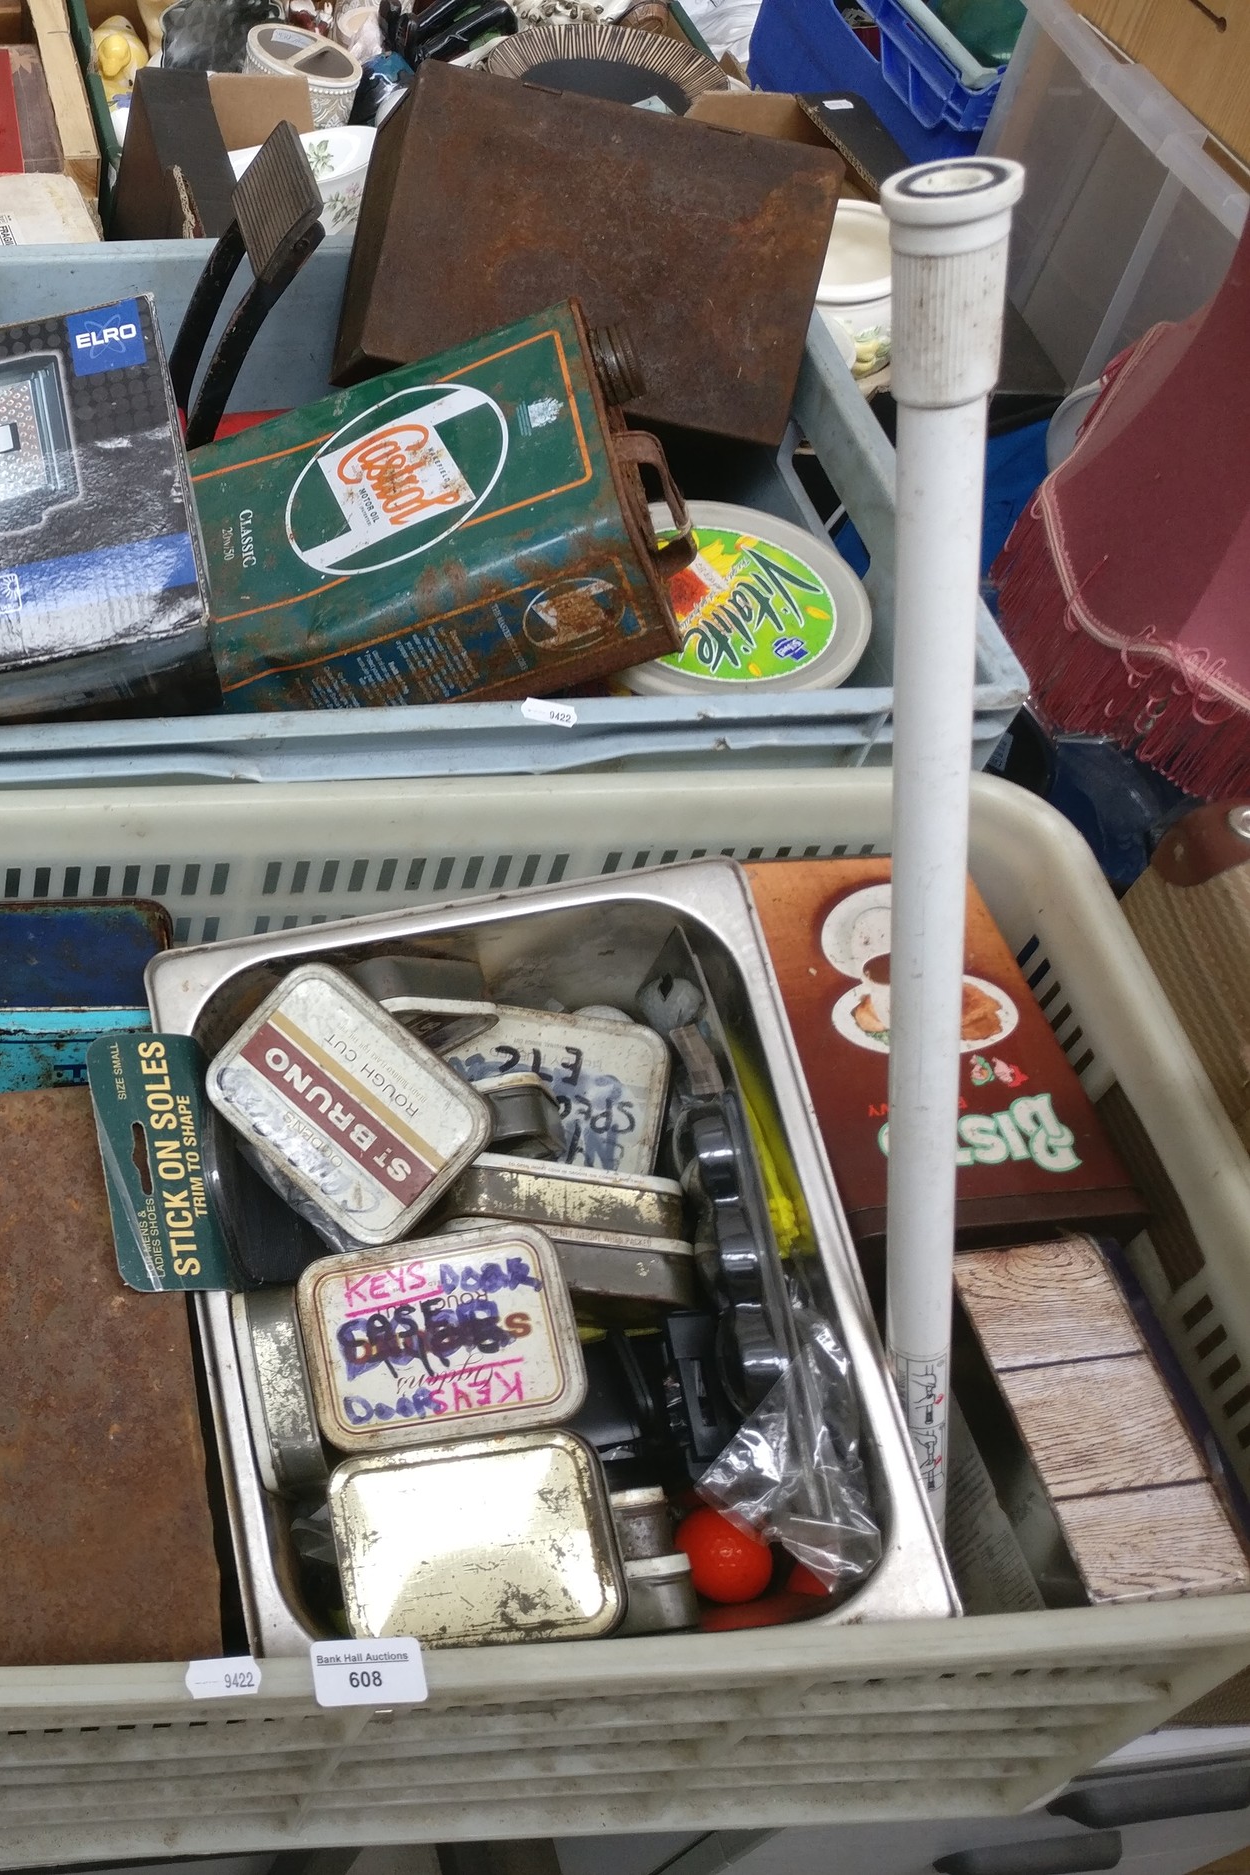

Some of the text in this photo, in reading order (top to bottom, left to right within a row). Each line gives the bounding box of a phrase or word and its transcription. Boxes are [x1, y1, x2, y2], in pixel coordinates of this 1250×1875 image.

[75, 322, 137, 349] ELRO
[337, 424, 460, 525] Castrol
[358, 487, 382, 523] MOTOR OIL
[239, 509, 257, 568] CLASSIC
[679, 545, 824, 674] Vitalite
[109, 1042, 127, 1100] SIZE SMALL
[324, 1033, 420, 1118] ROUGH CUT
[495, 1045, 583, 1087] ETC
[265, 1047, 378, 1152] BRUNO
[138, 1041, 201, 1277] STICK ON SOLES
[176, 1095, 209, 1218] TRIM TO SHAPE
[137, 1209, 146, 1219] &
[139, 1219, 152, 1252] MENS
[145, 1197, 165, 1279] LADIES SHOES
[344, 1261, 426, 1307] KEYS
[429, 1371, 525, 1415] KEYS
[224, 1671, 255, 1689] 9422
[316, 1652, 409, 1664] Bank Hall Auctions
[349, 1671, 383, 1688] 608
